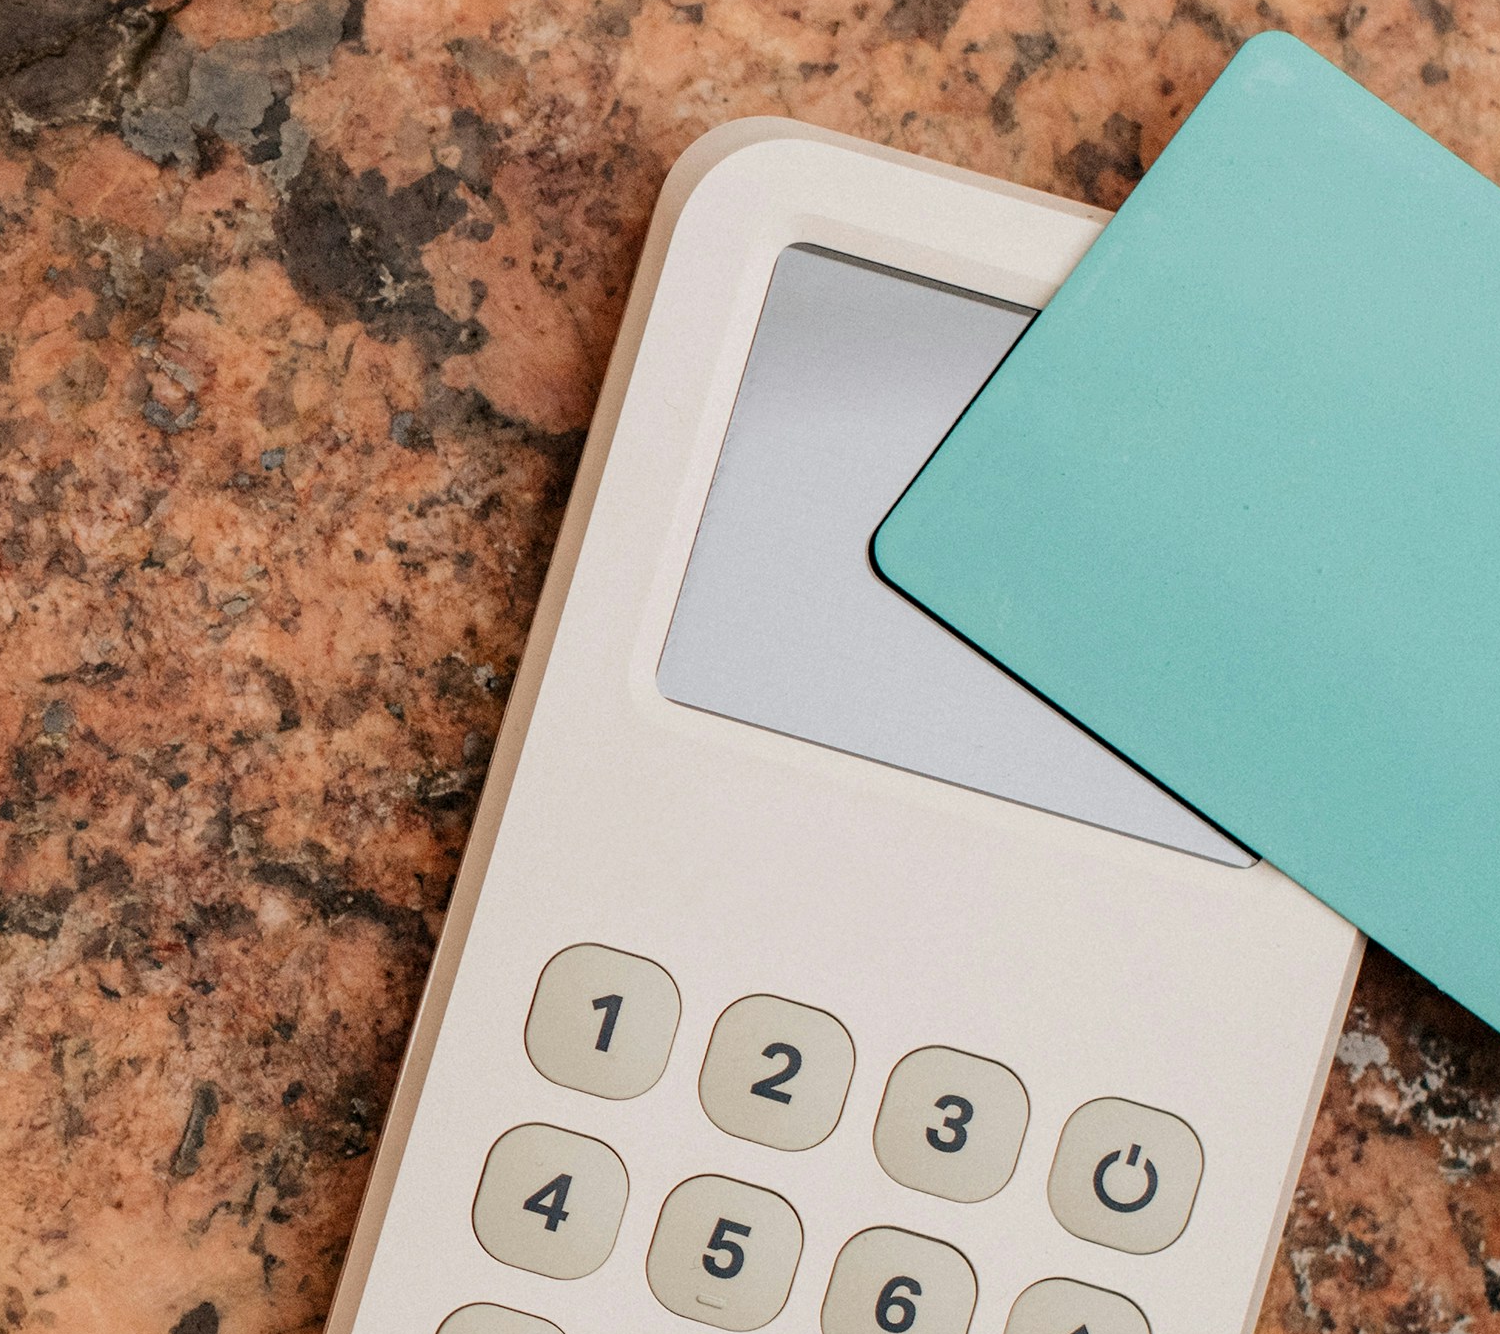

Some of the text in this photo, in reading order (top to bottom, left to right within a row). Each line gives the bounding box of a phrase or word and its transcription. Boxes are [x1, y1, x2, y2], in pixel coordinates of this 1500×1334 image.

[591, 993, 975, 1154] 1 2 3
[522, 1173, 923, 1334] 4 5 6
